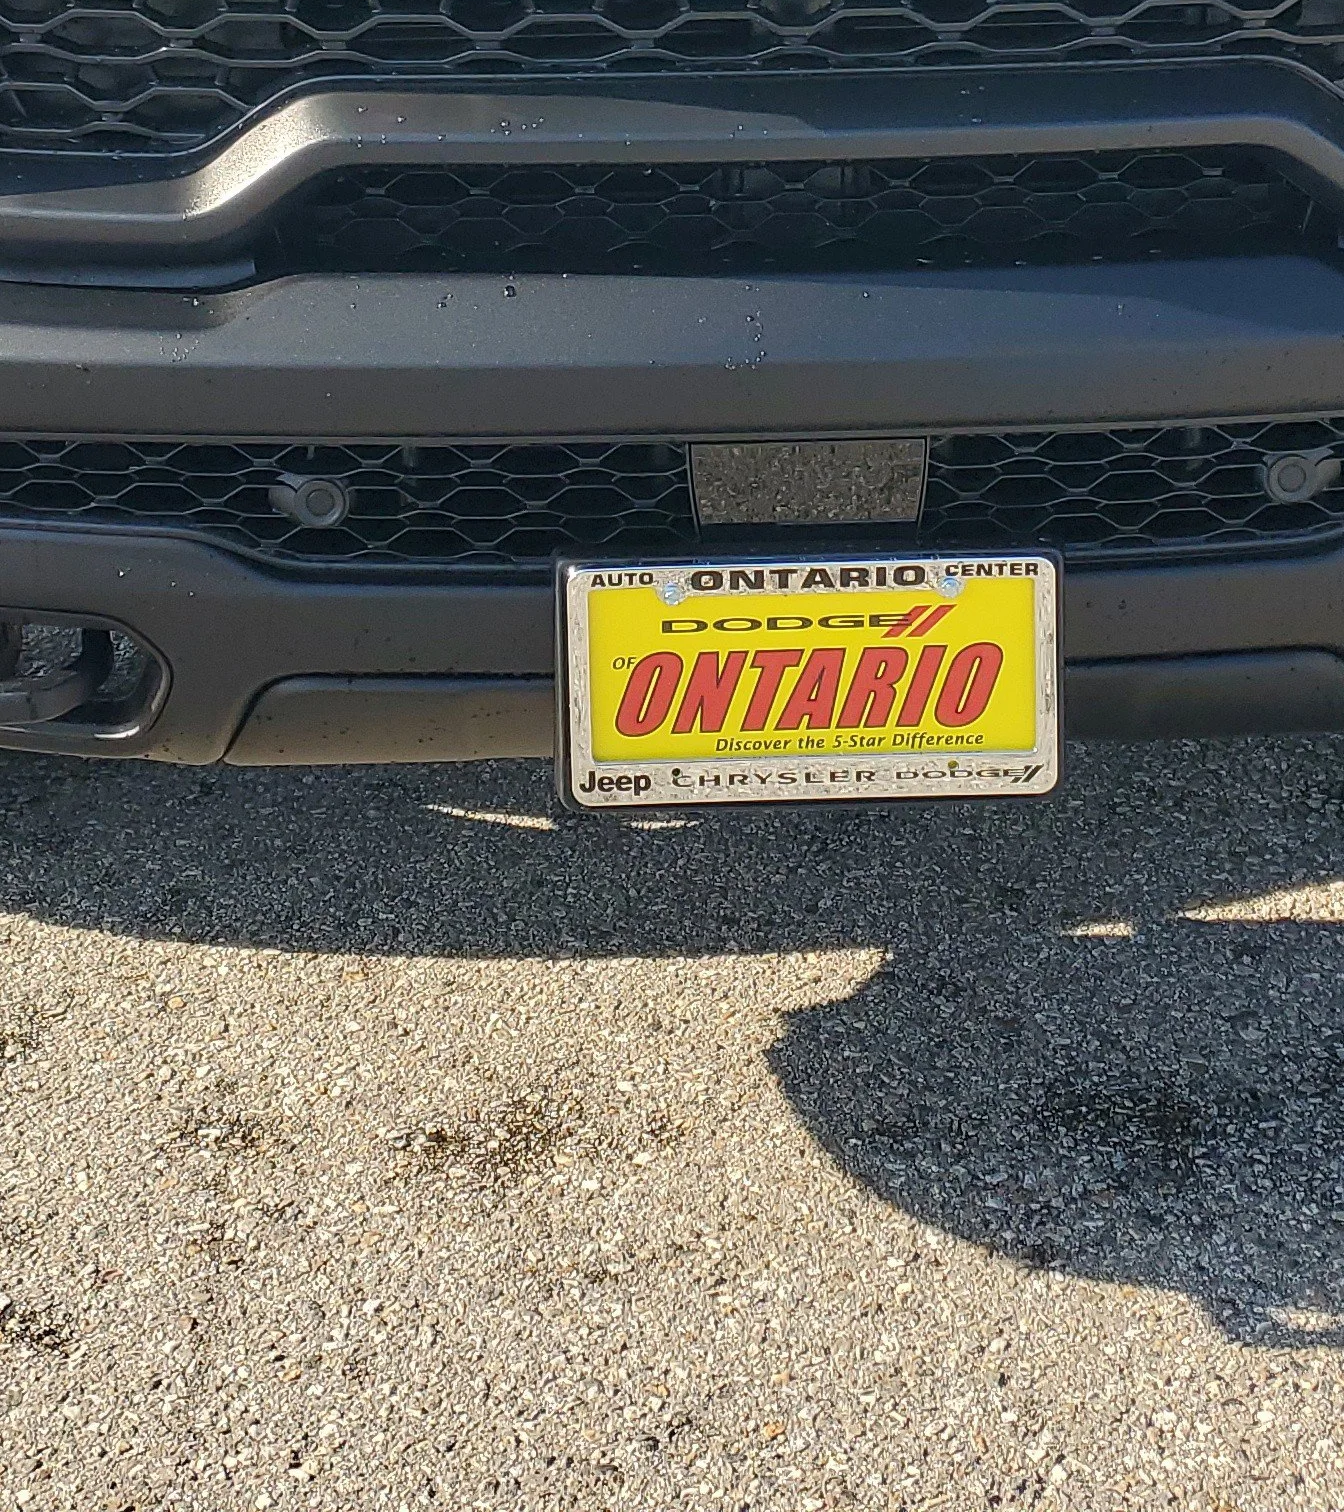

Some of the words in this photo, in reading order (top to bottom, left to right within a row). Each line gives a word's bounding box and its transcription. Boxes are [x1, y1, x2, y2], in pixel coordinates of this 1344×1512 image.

[591, 572, 654, 588] AUTO
[691, 565, 926, 591] ONTARIO
[944, 562, 1039, 577] CENTER
[661, 613, 913, 634] DODGE
[612, 656, 636, 670] OF
[614, 642, 1004, 738] ONTARIO
[715, 738, 791, 752] Discover
[798, 736, 825, 749] the
[832, 733, 886, 748] 5-Star
[892, 731, 984, 748] Difference
[579, 771, 652, 796] Jeep
[672, 771, 876, 788] CHRYSLER
[895, 768, 1027, 780] DODGE
